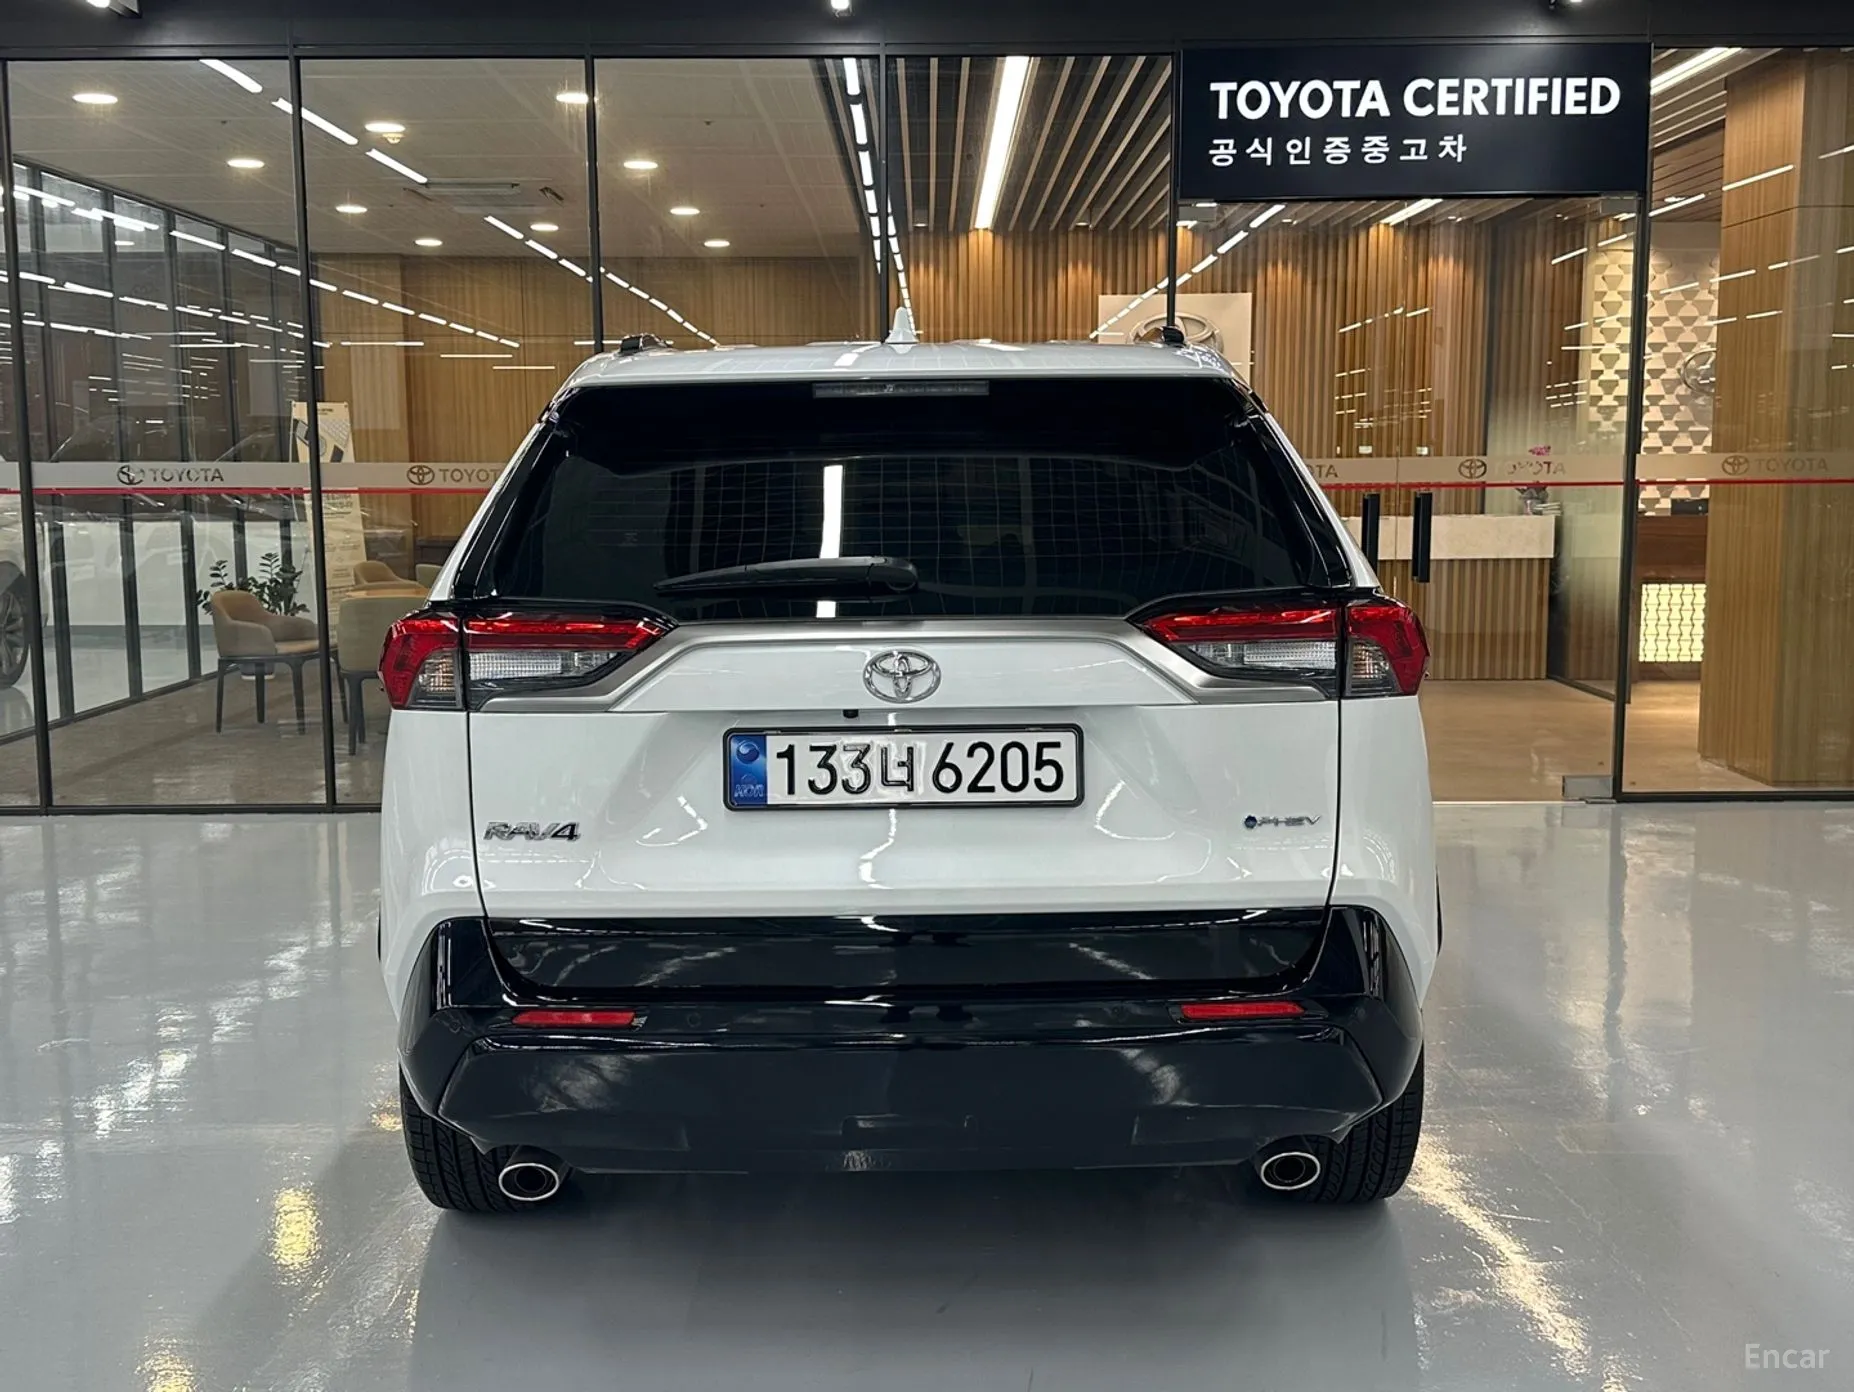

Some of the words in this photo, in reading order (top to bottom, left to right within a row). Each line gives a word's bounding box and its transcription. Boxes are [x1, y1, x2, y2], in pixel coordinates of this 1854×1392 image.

[1209, 79, 1391, 120] TOYOTA
[1403, 77, 1621, 117] CERTIFIED
[1208, 134, 1467, 166] 공식인증중고차
[149, 467, 224, 482] TOYOTA
[439, 468, 503, 483] TOYOT
[1755, 457, 1829, 473] TOYOTA
[776, 743, 915, 796] 133너
[932, 741, 1064, 794] 6205
[483, 821, 580, 842] RAV4
